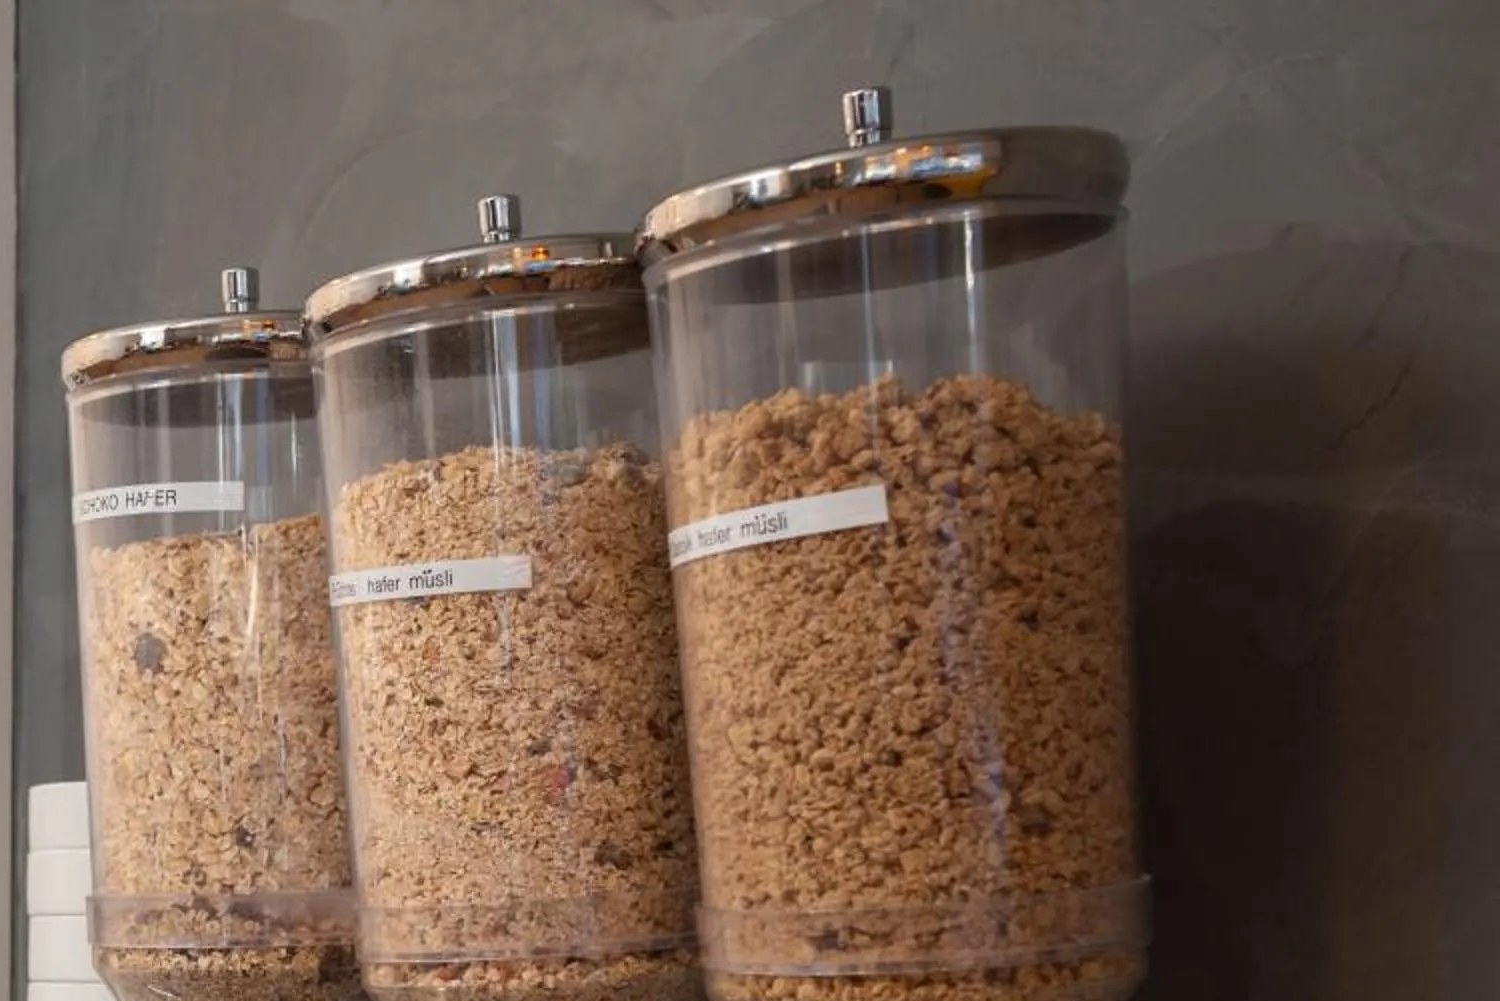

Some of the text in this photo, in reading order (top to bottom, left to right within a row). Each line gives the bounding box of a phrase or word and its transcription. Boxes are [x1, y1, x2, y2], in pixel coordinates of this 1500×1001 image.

[125, 489, 178, 508] HAFER
[740, 511, 789, 538] müsli
[366, 576, 403, 594] hafer
[409, 568, 454, 590] müsli
